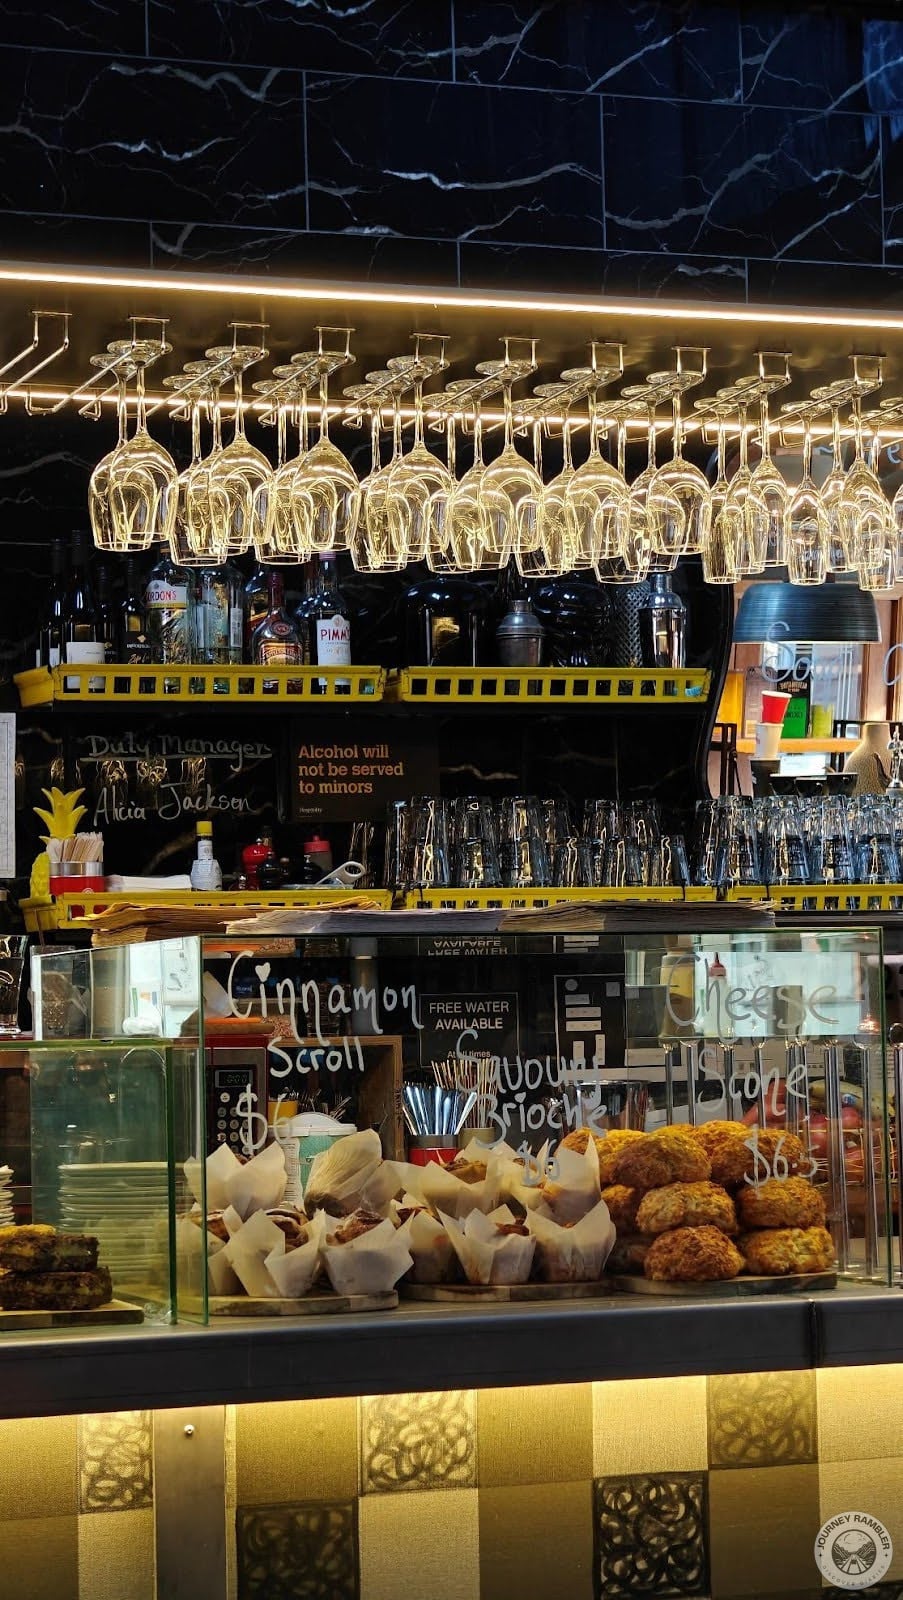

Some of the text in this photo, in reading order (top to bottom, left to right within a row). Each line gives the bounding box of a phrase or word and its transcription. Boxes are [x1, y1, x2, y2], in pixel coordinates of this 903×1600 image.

[86, 731, 150, 758] Duty
[298, 744, 390, 759] Alcohol will
[298, 761, 405, 777] not be served
[299, 779, 374, 794] to minors
[93, 784, 147, 827] Alicia
[228, 950, 425, 1047] Cinnamon
[429, 1000, 510, 1014] FREE WATER
[665, 954, 840, 1044] Cheese
[435, 1017, 504, 1031] AVAILABLE
[267, 1035, 365, 1078] Scroll
[698, 1048, 807, 1117] Scone
[236, 1083, 294, 1156] $6
[475, 1091, 608, 1150] Brioche
[516, 1138, 561, 1187] $6
